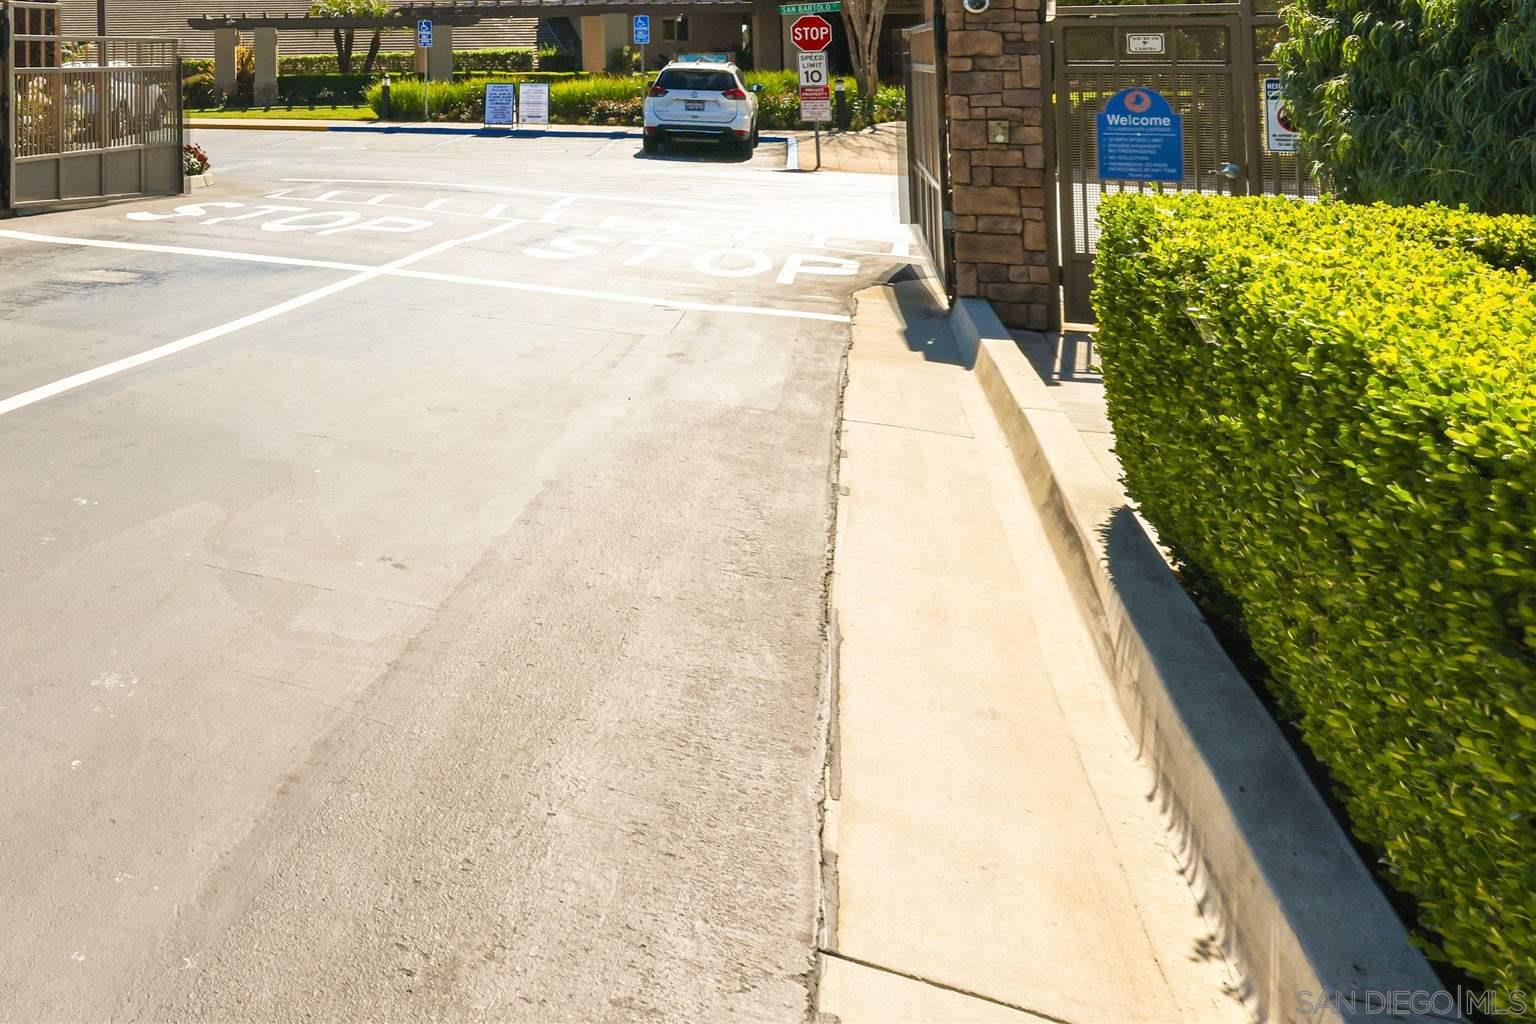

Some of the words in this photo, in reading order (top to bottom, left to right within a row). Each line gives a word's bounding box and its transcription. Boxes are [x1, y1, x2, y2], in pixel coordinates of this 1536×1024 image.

[799, 3, 831, 13] BARTOLO
[794, 27, 829, 41] STOP
[804, 70, 822, 83] 10
[1106, 114, 1172, 126] Welcome
[126, 202, 435, 235] STOP
[522, 235, 861, 284] STOP
